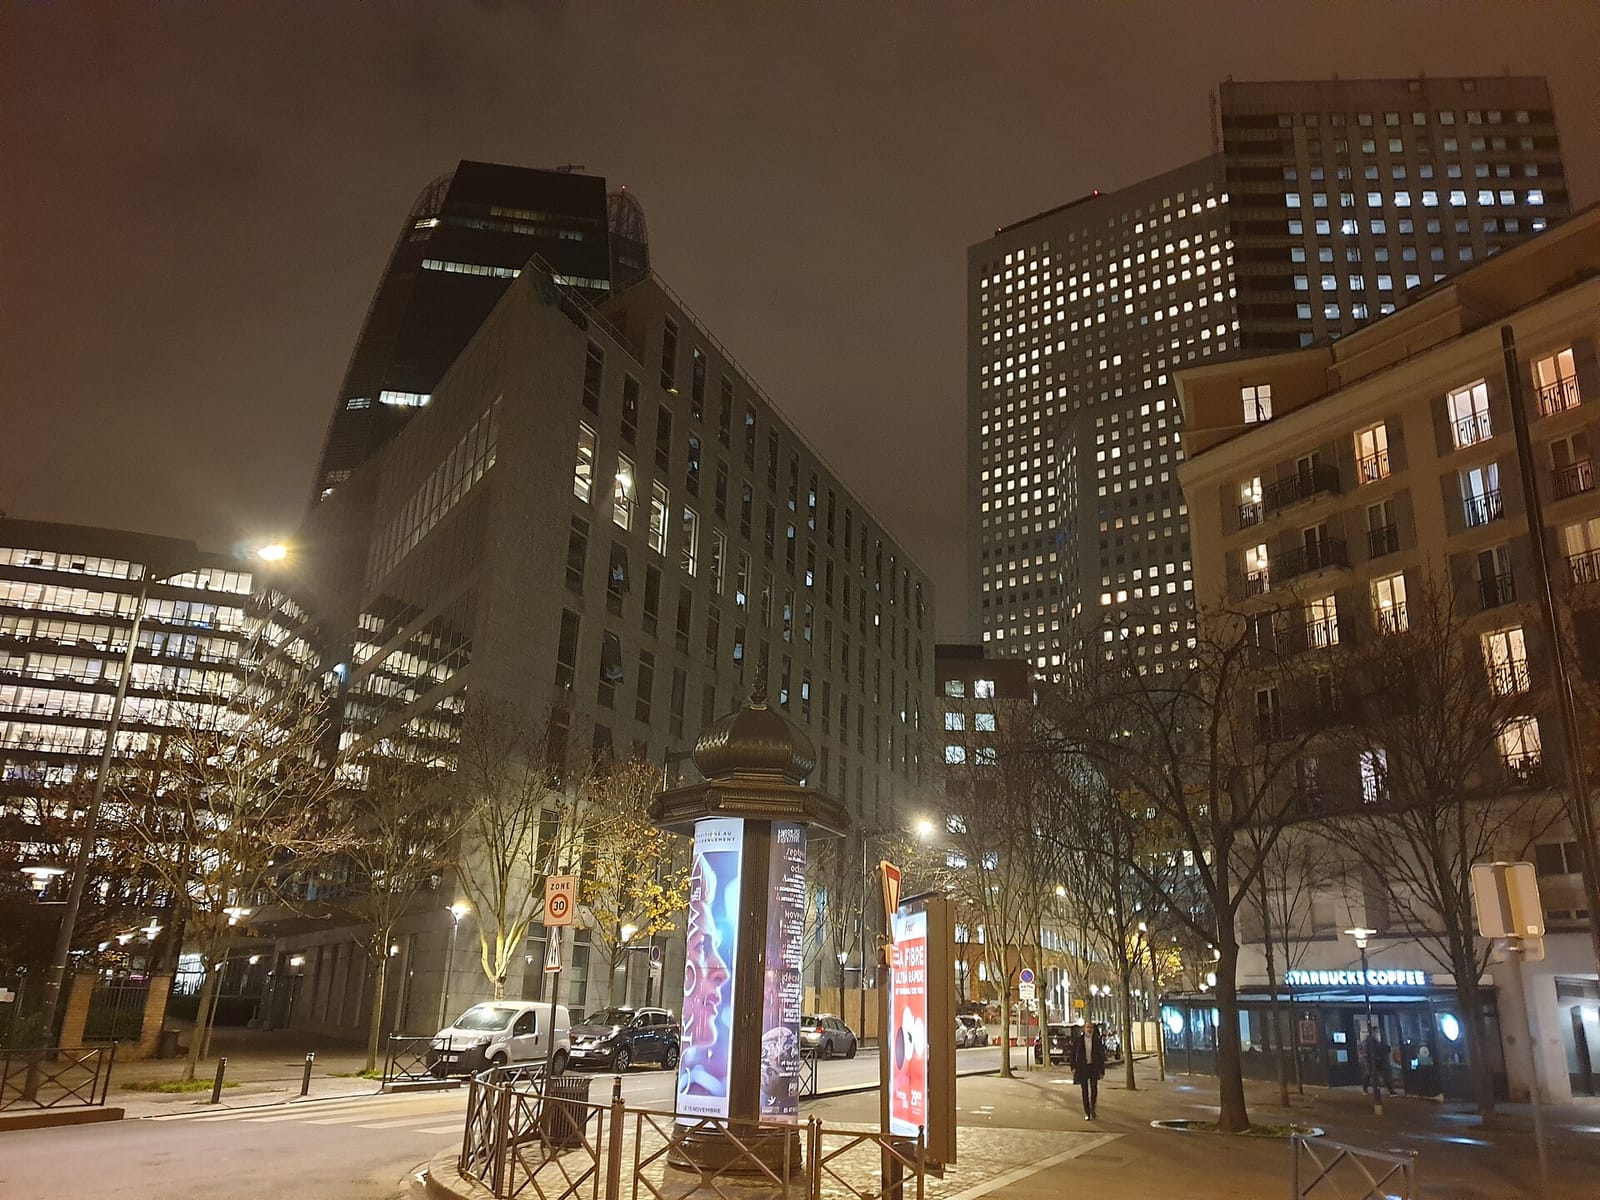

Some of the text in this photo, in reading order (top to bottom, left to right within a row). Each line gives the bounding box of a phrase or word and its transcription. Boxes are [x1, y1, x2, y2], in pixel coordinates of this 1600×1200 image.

[551, 882, 570, 890] ZONE
[553, 901, 564, 911] 30
[905, 945, 924, 968] FIBRE
[1285, 969, 1425, 985] STARBUCKS COFFEE
